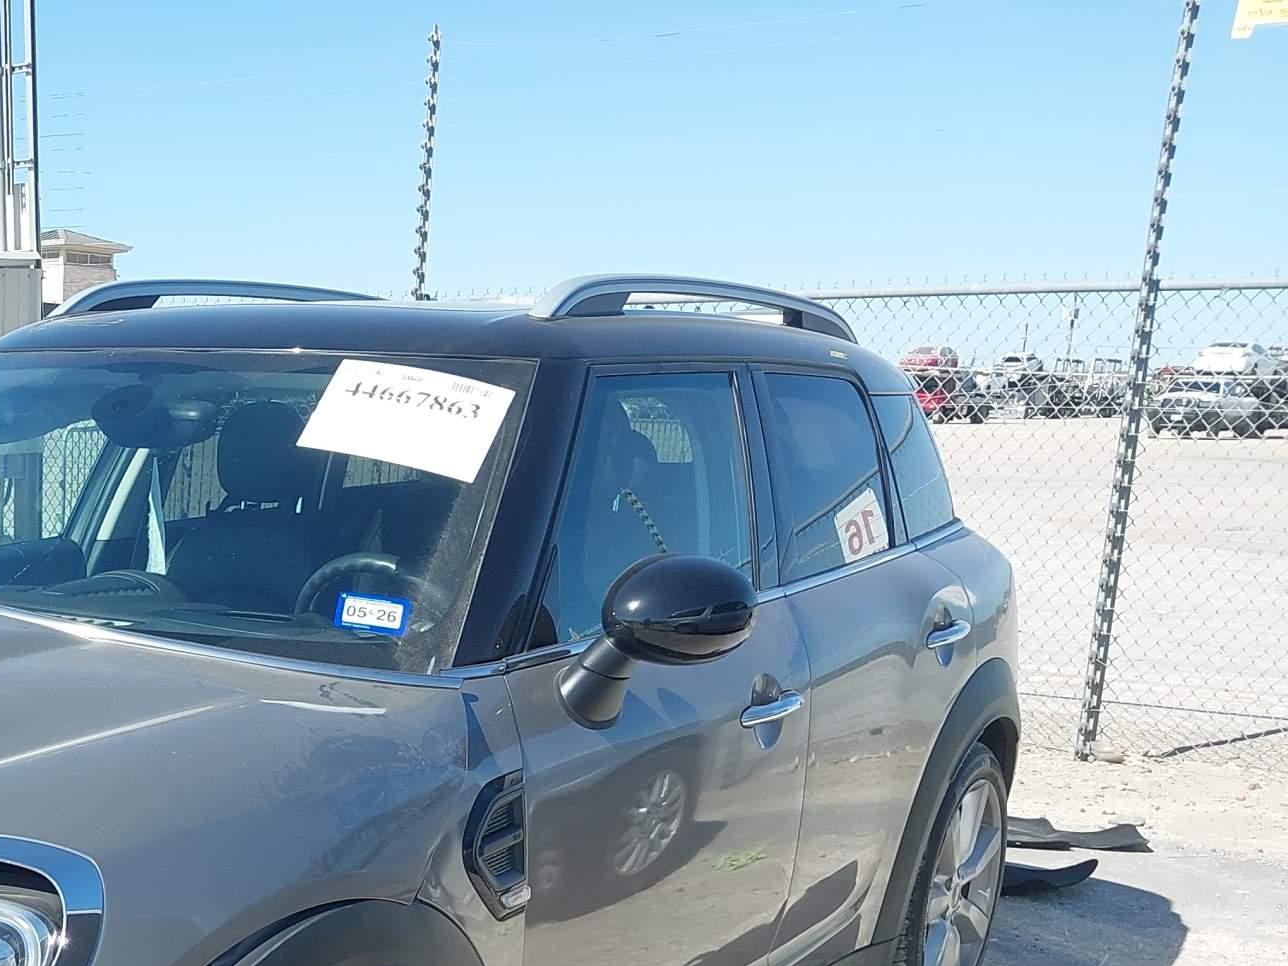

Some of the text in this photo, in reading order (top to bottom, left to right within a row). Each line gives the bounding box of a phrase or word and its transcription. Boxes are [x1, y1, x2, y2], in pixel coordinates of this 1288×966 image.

[345, 380, 481, 420] 44667863
[346, 605, 397, 623] 05 26
